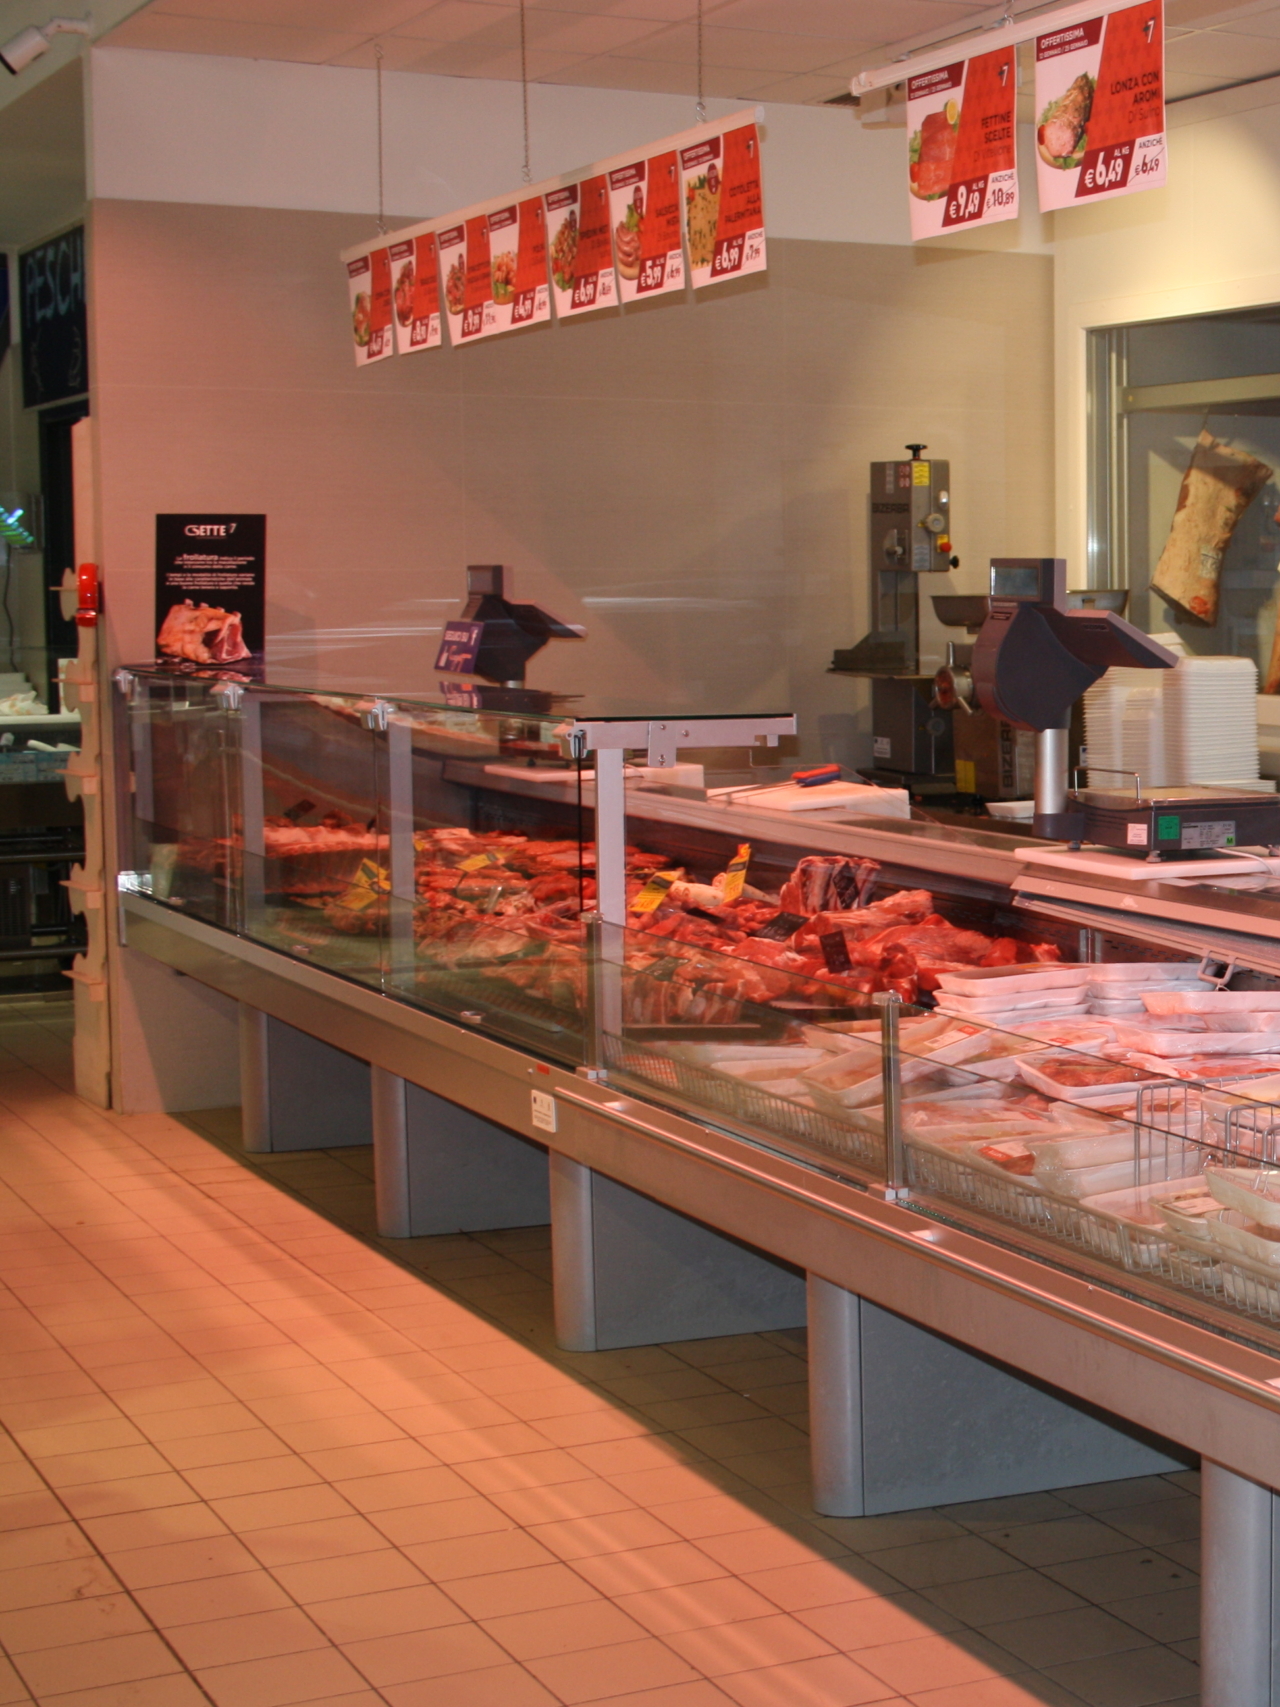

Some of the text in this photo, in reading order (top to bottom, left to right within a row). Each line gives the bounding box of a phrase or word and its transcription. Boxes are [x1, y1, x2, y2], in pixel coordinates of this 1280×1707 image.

[1041, 27, 1085, 49] OFFERTISSIMA
[1110, 71, 1160, 95] LONZA CON
[1132, 88, 1160, 105] AROMI
[981, 111, 1012, 129] FETTINE
[984, 126, 1012, 144] SCELTE
[1114, 146, 1130, 157] AL KG
